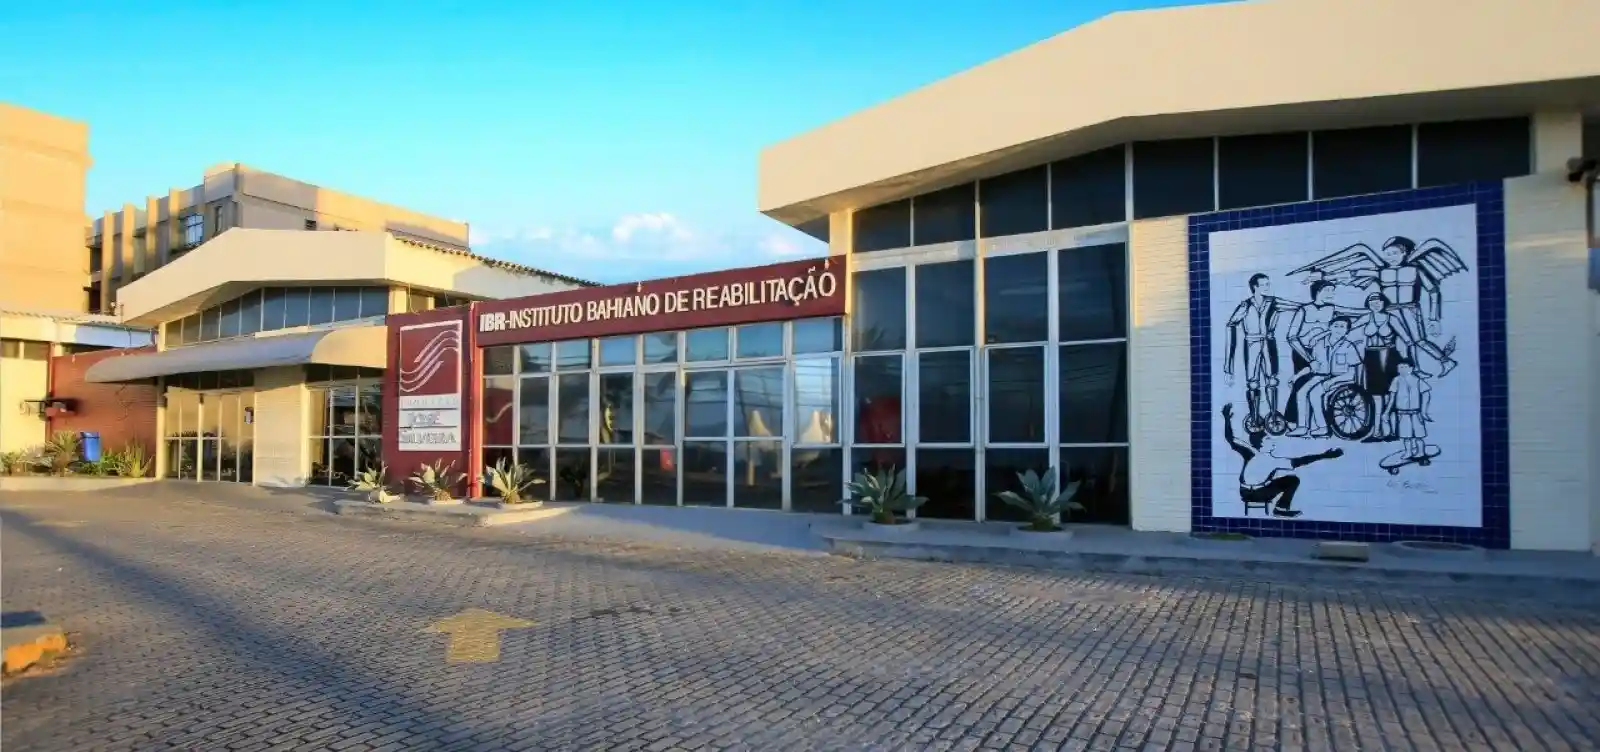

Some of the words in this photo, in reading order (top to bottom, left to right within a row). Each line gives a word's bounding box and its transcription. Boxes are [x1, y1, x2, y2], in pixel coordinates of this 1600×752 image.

[480, 302, 583, 332] IBR-INSTITUTO
[587, 292, 660, 321] BAHIANO
[664, 290, 689, 313] DE
[692, 265, 836, 311] REABILITAÇÃO
